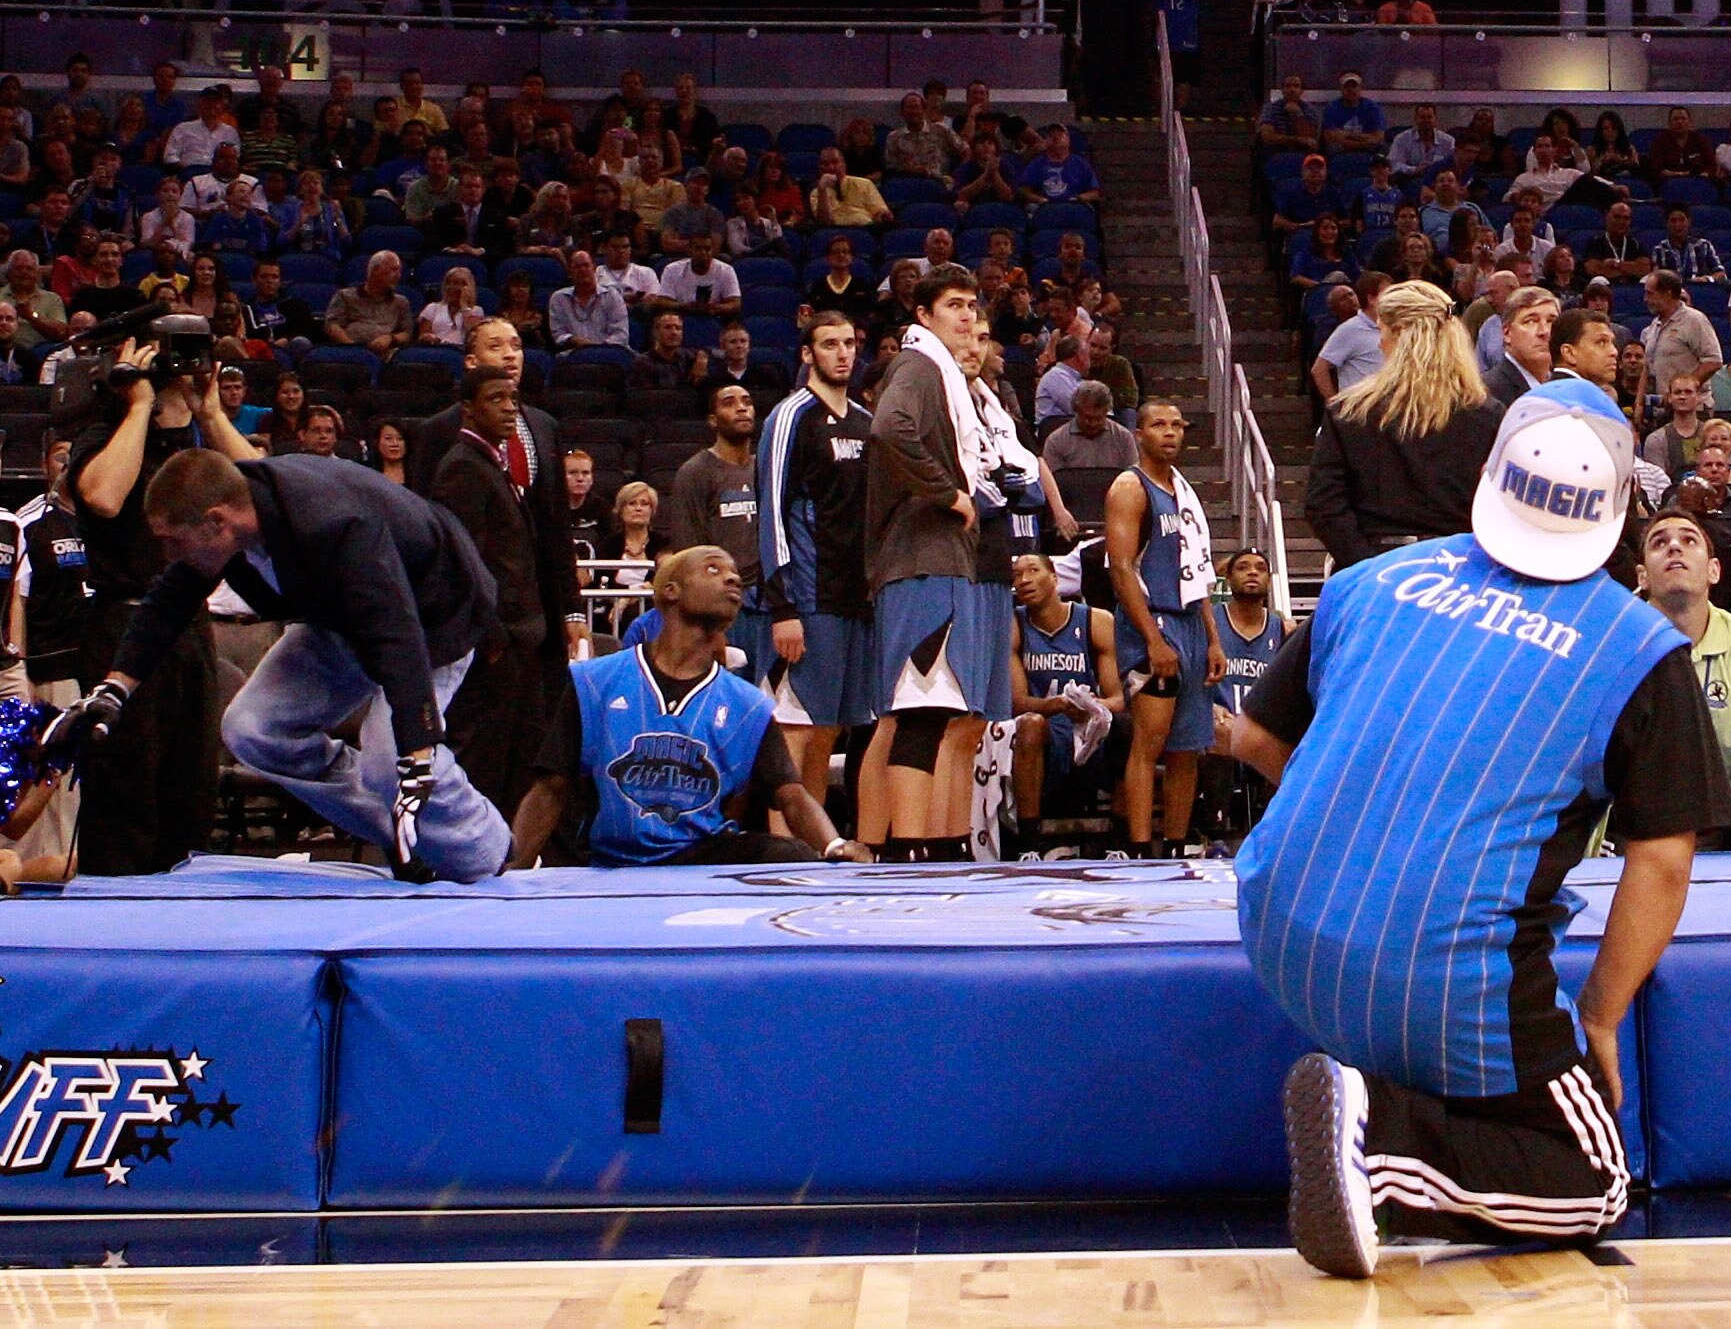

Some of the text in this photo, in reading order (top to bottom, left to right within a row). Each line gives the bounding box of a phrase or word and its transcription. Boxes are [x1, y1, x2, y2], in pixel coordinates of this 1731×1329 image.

[1502, 460, 1607, 522] MAGIC
[1023, 652, 1086, 673] MINNESOTA
[633, 735, 707, 768] MAGIC
